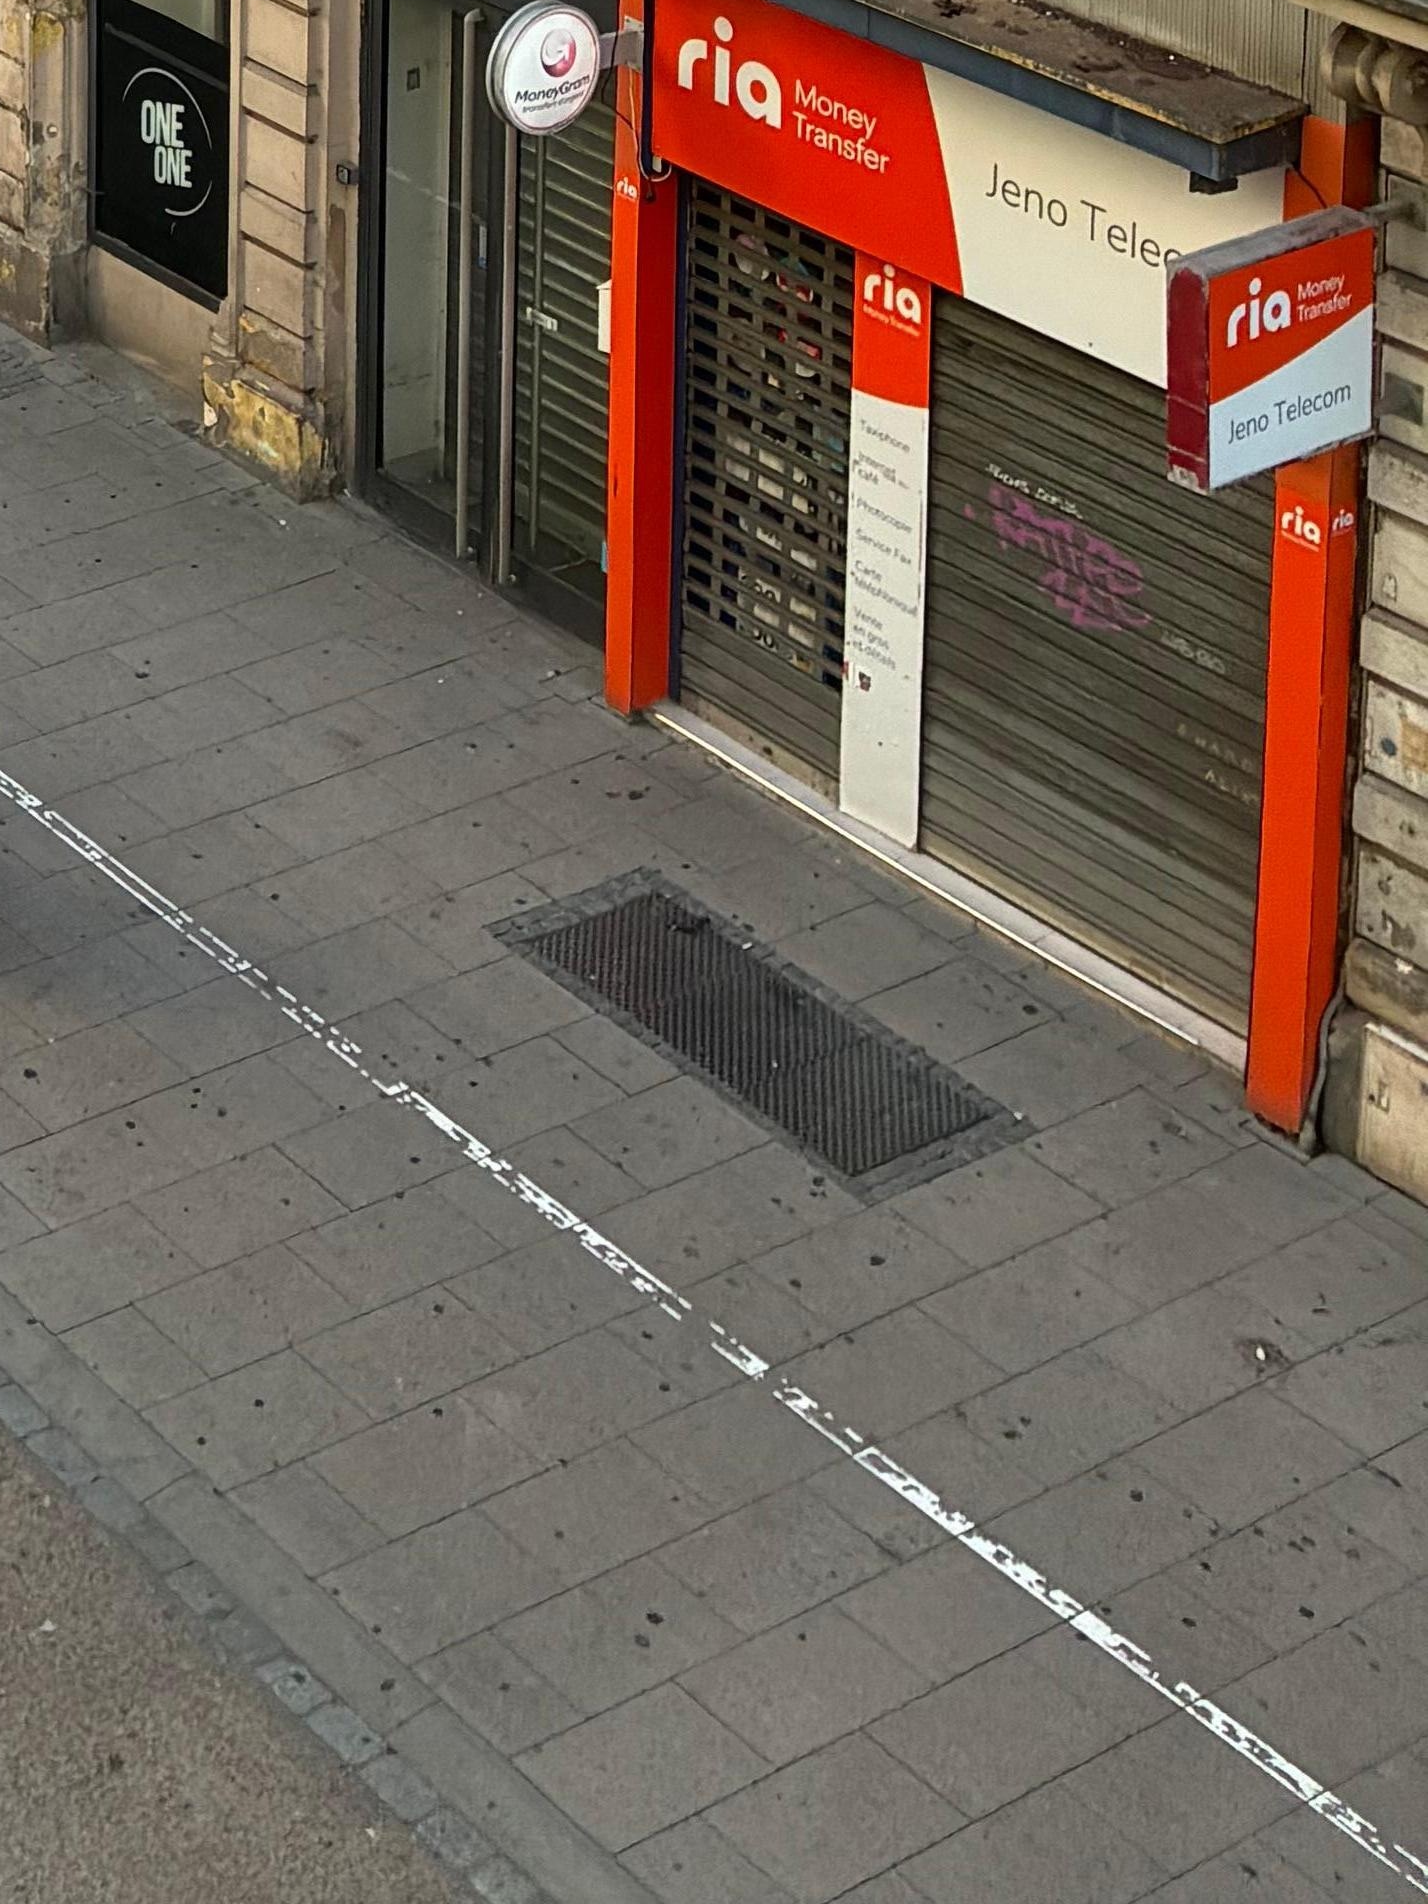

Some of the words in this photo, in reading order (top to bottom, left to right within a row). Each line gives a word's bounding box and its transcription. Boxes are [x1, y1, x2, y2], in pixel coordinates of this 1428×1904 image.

[514, 74, 591, 104] MoneyGram
[678, 16, 782, 130] ria
[140, 99, 185, 148] ONE
[794, 79, 877, 140] Money
[154, 145, 193, 188] ONE
[792, 110, 891, 175] Transfer
[616, 176, 639, 201] ria
[985, 163, 1069, 229] Jeno
[1080, 198, 1182, 270] Telec
[863, 264, 922, 325] ria
[1297, 274, 1345, 302] Money
[1297, 293, 1352, 322] Transfer
[1227, 277, 1292, 349] ria
[1228, 413, 1270, 445] Jeno
[1273, 383, 1352, 426] Telecom
[1281, 505, 1321, 545] ria
[1331, 508, 1355, 531] ria
